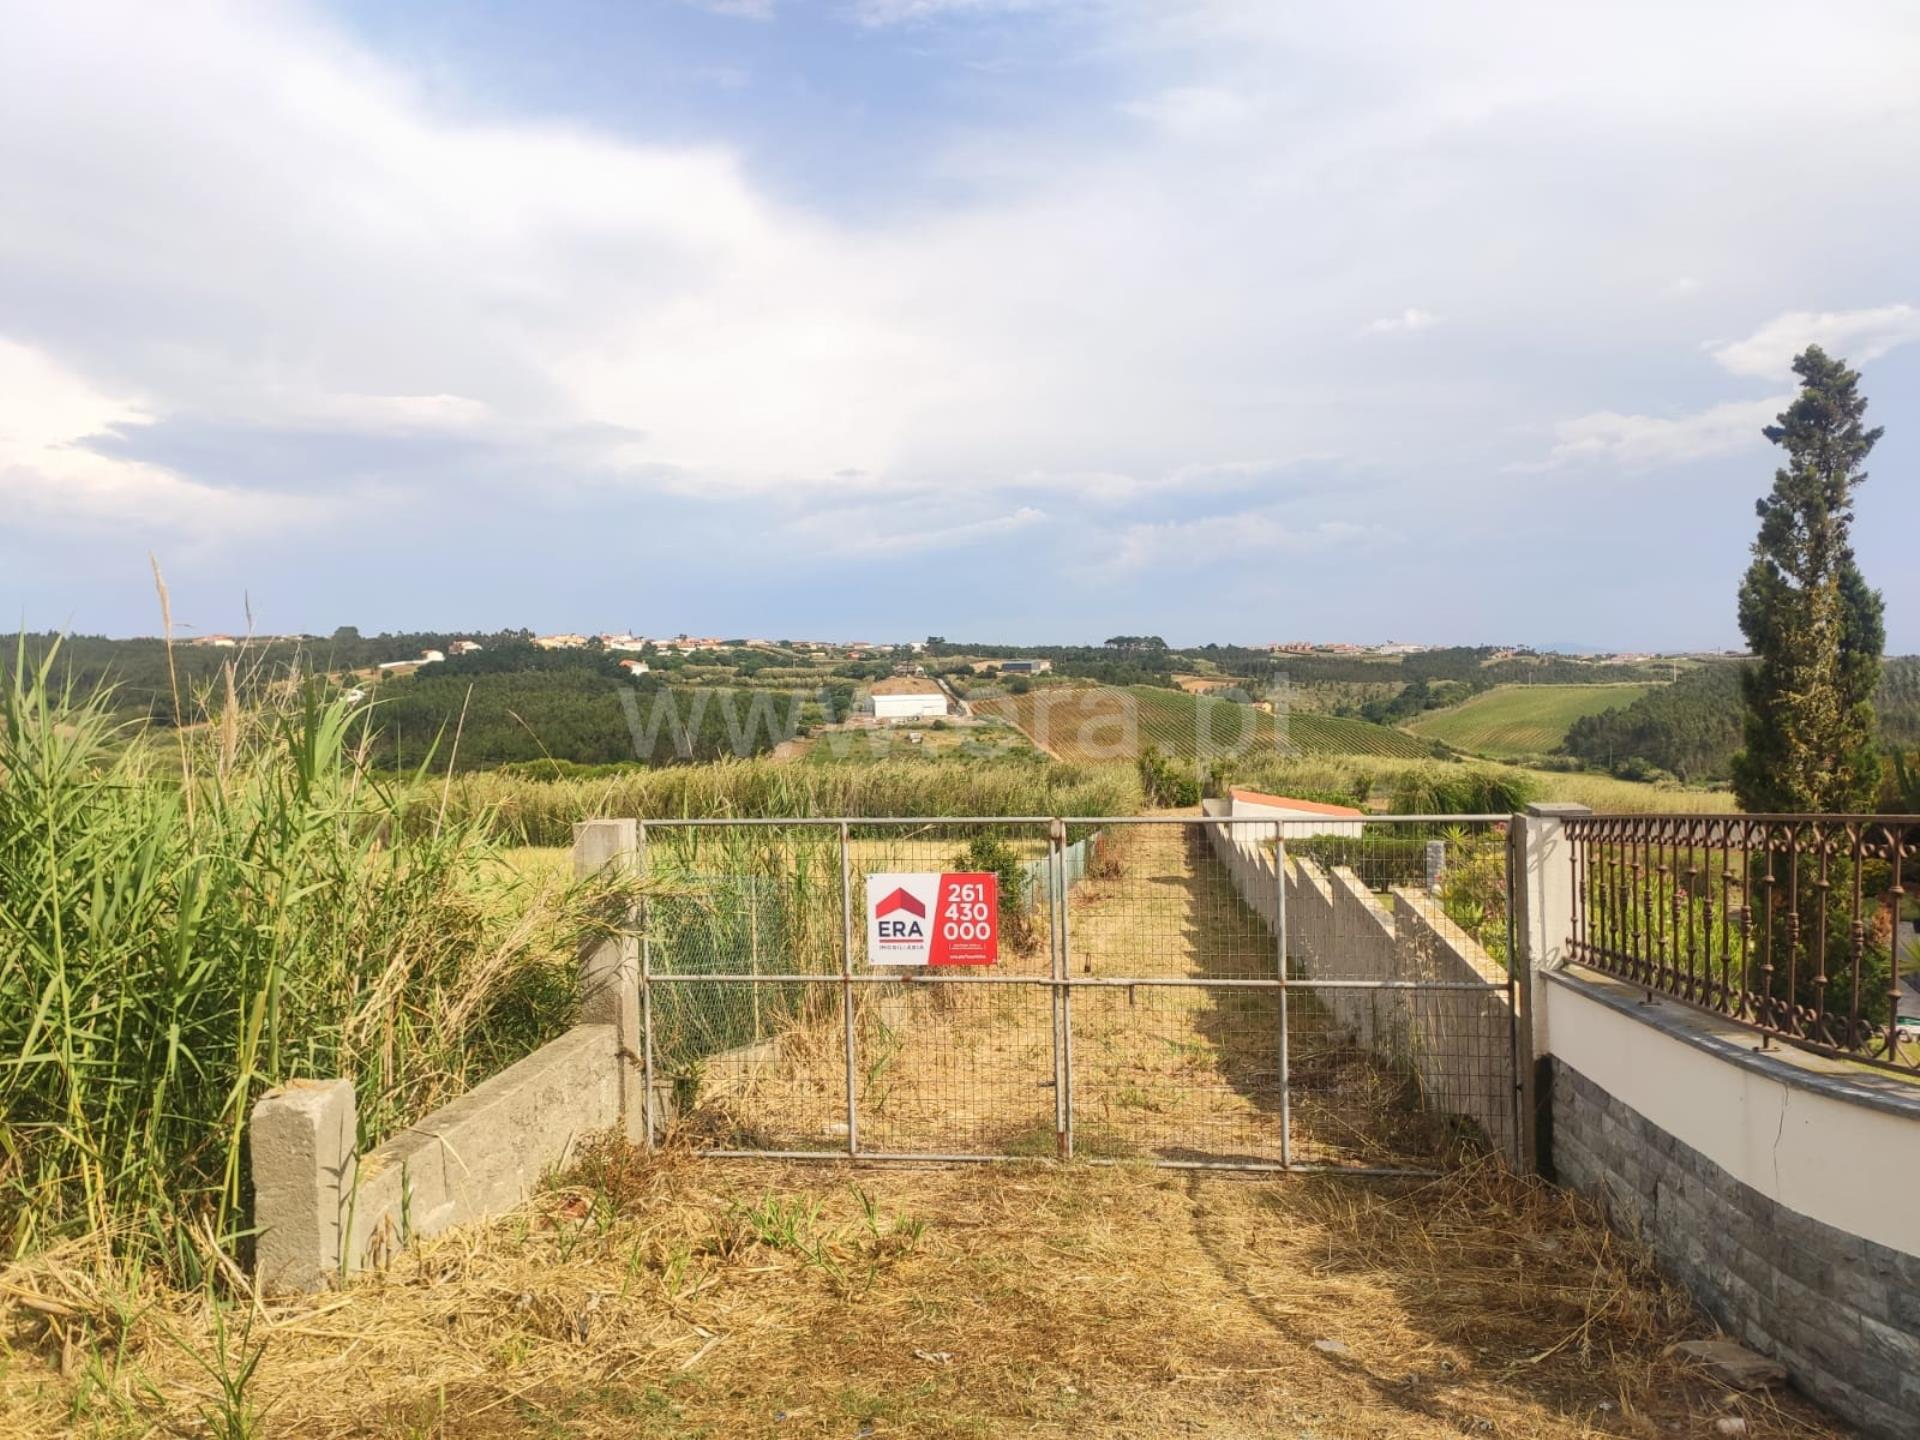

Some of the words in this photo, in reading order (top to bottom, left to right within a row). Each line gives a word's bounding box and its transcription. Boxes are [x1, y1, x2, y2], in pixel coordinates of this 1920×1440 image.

[948, 884, 984, 902] 261
[944, 903, 988, 921] 430
[878, 921, 923, 937] ERA
[943, 922, 990, 940] 000
